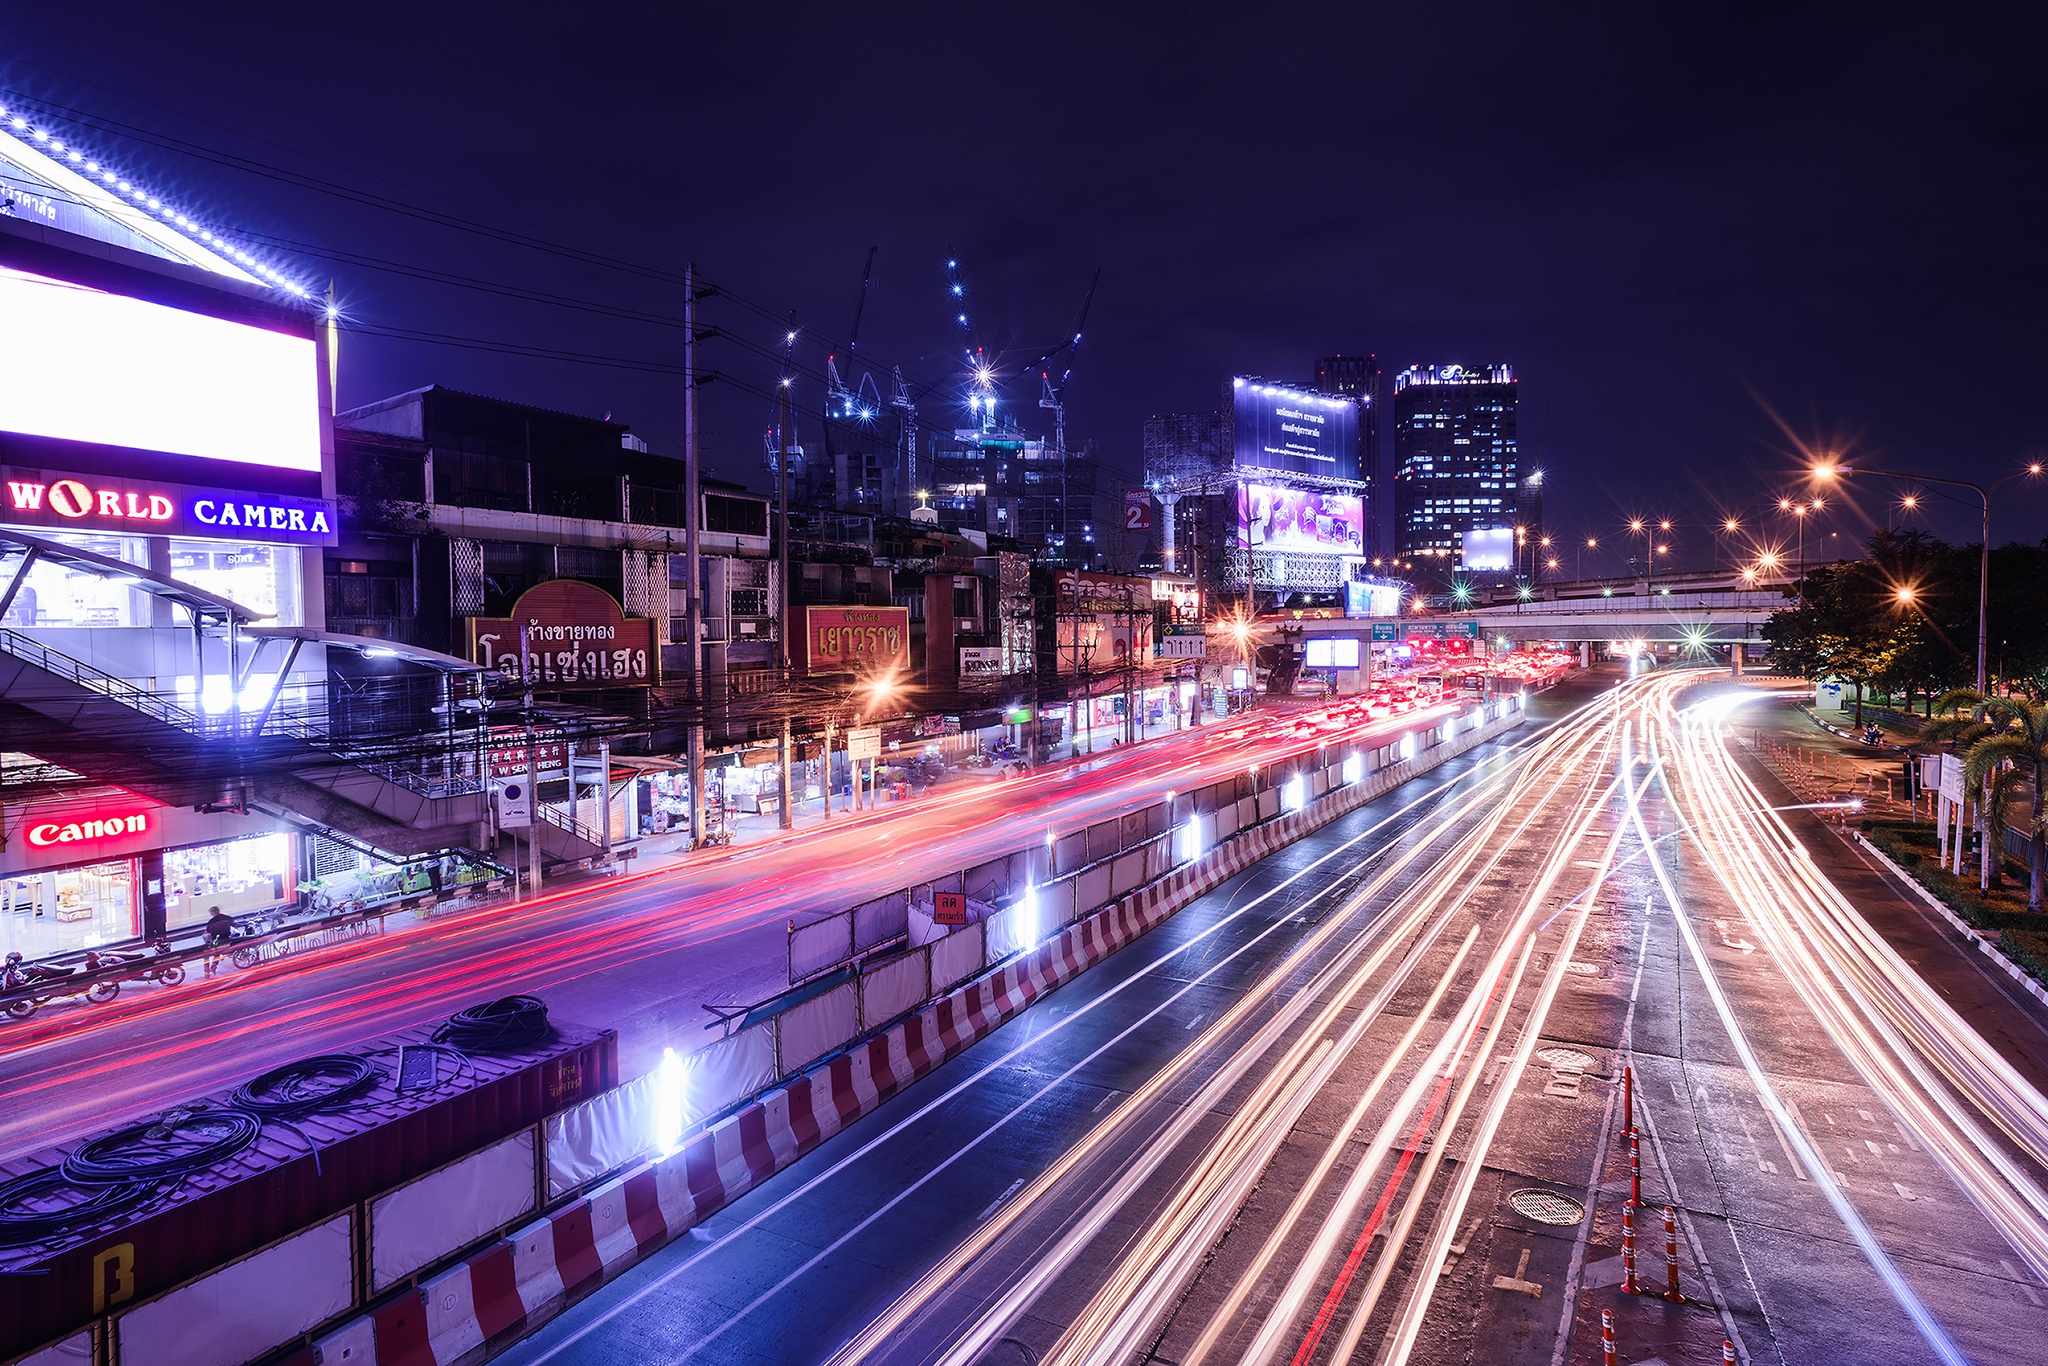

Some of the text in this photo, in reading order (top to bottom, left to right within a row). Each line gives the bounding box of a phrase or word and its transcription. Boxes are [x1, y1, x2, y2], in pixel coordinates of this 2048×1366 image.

[8, 480, 331, 533] WORLD CAMERA
[228, 554, 254, 564] SONY
[843, 610, 880, 622] ห้างทอง
[818, 624, 901, 656] เยาวราช
[511, 763, 528, 774] SEN
[537, 759, 562, 770] HENG
[29, 814, 146, 846] Canon
[942, 896, 957, 908] ลด
[937, 911, 963, 921] ความเร็ว
